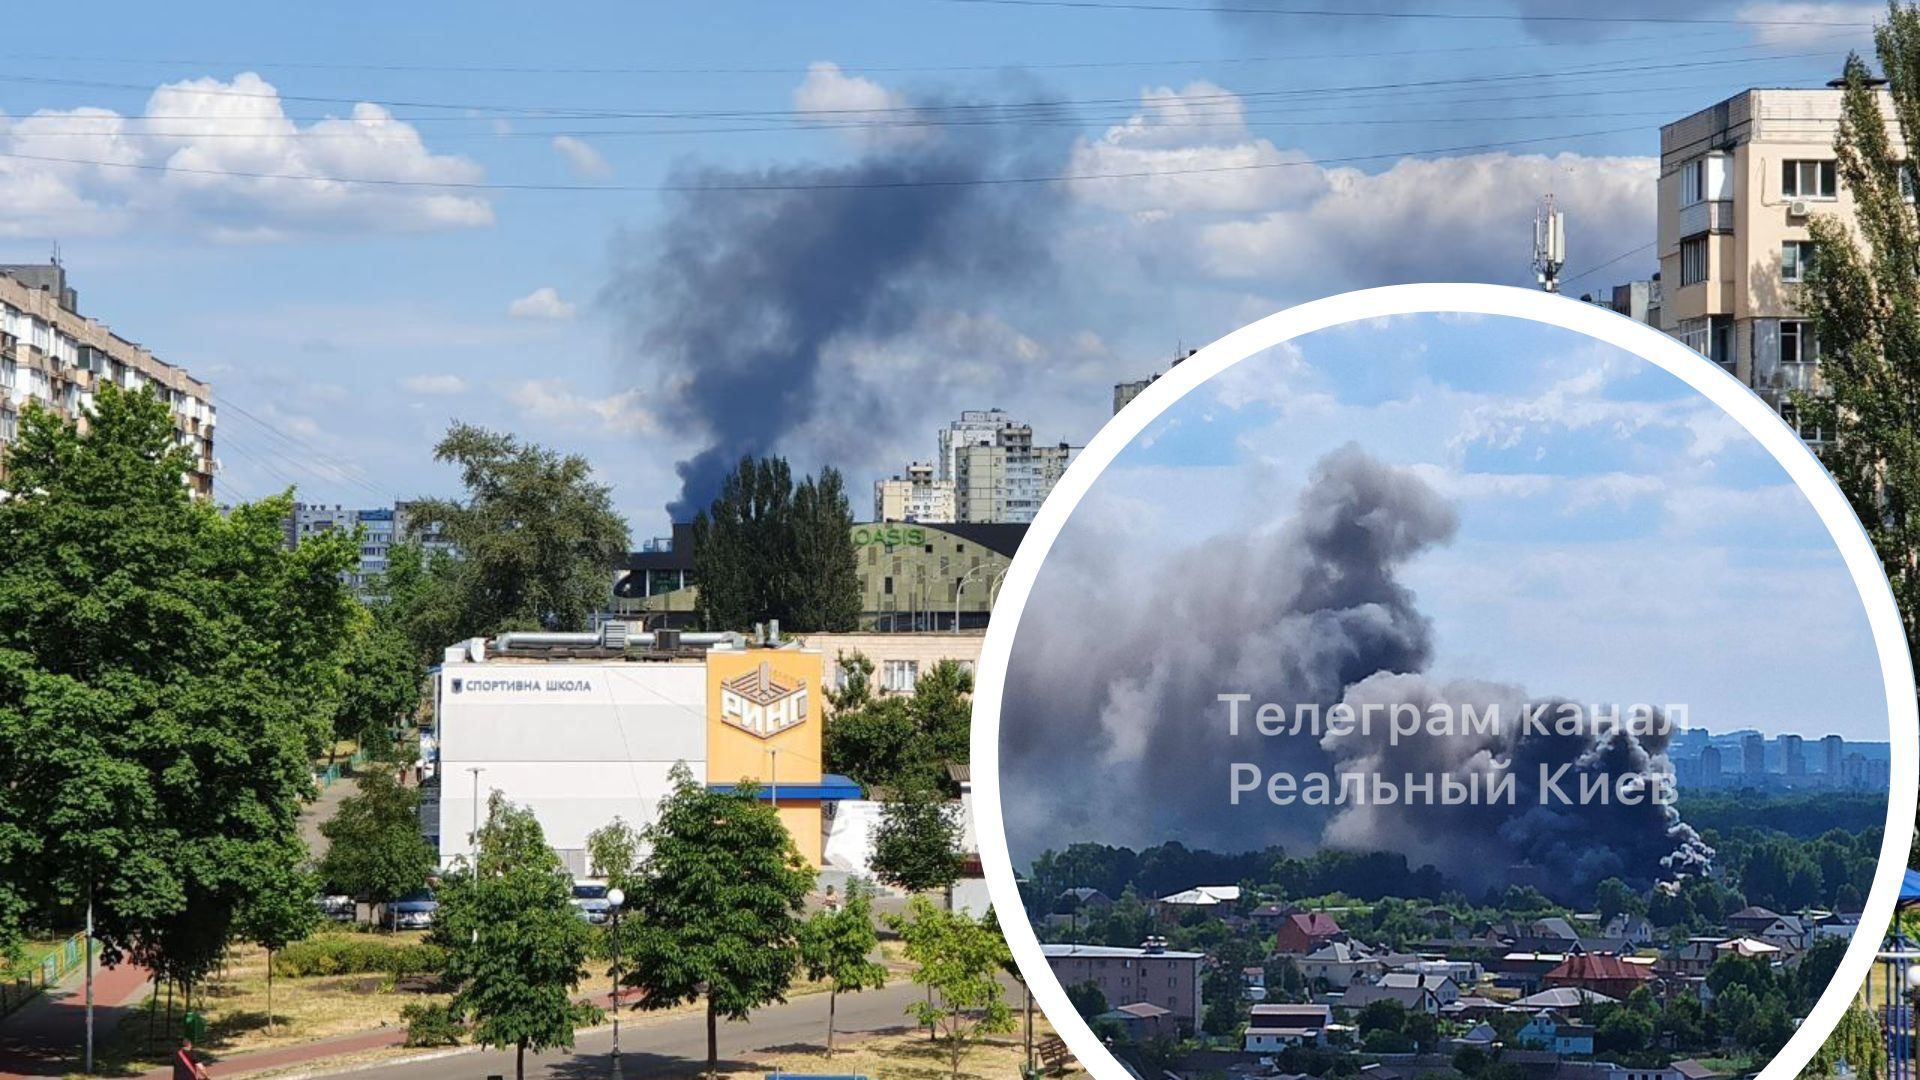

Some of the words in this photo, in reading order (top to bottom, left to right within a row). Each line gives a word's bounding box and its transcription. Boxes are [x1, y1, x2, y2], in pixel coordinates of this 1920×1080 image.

[854, 529, 925, 546] OASIS
[466, 679, 541, 692] СПОРТИВНА
[546, 679, 592, 693] ШКОЛА
[721, 687, 807, 734] РИНГ
